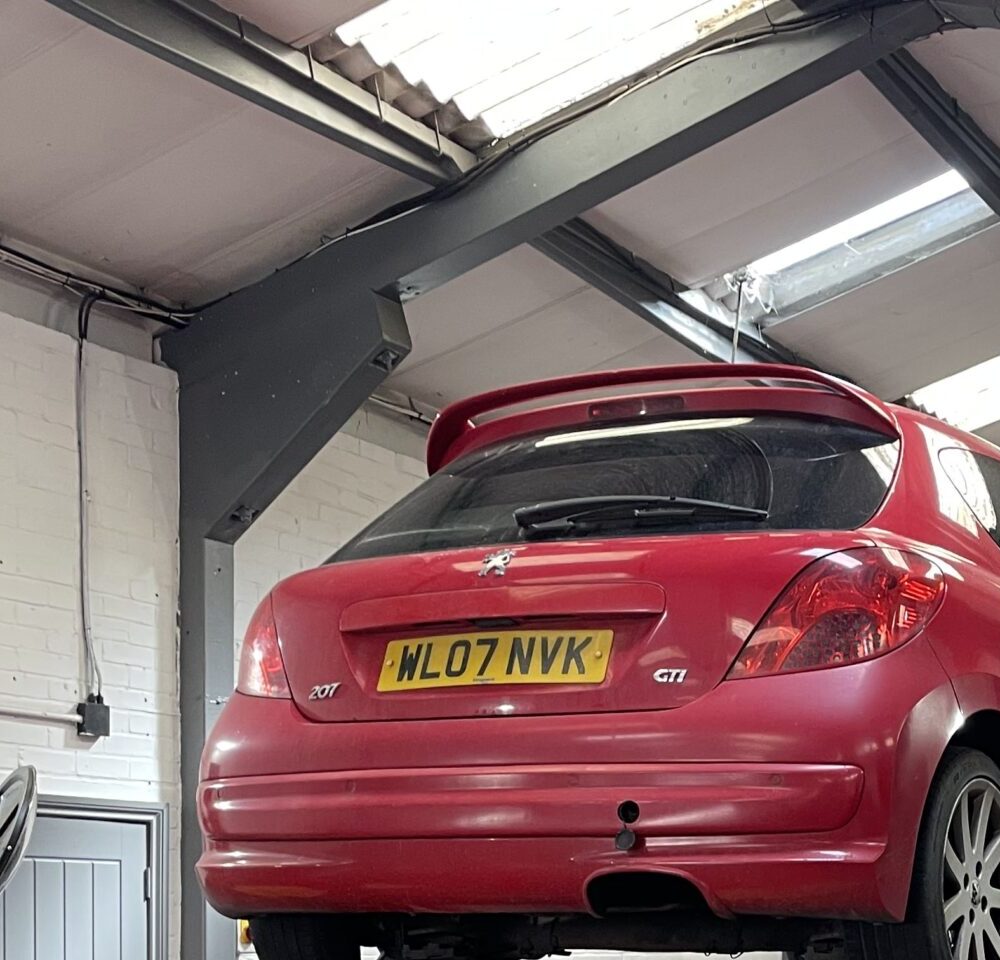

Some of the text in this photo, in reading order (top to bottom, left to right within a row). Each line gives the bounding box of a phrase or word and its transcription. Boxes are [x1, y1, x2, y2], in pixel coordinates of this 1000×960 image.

[396, 636, 593, 683] WL07 NVK
[308, 682, 342, 699] 207
